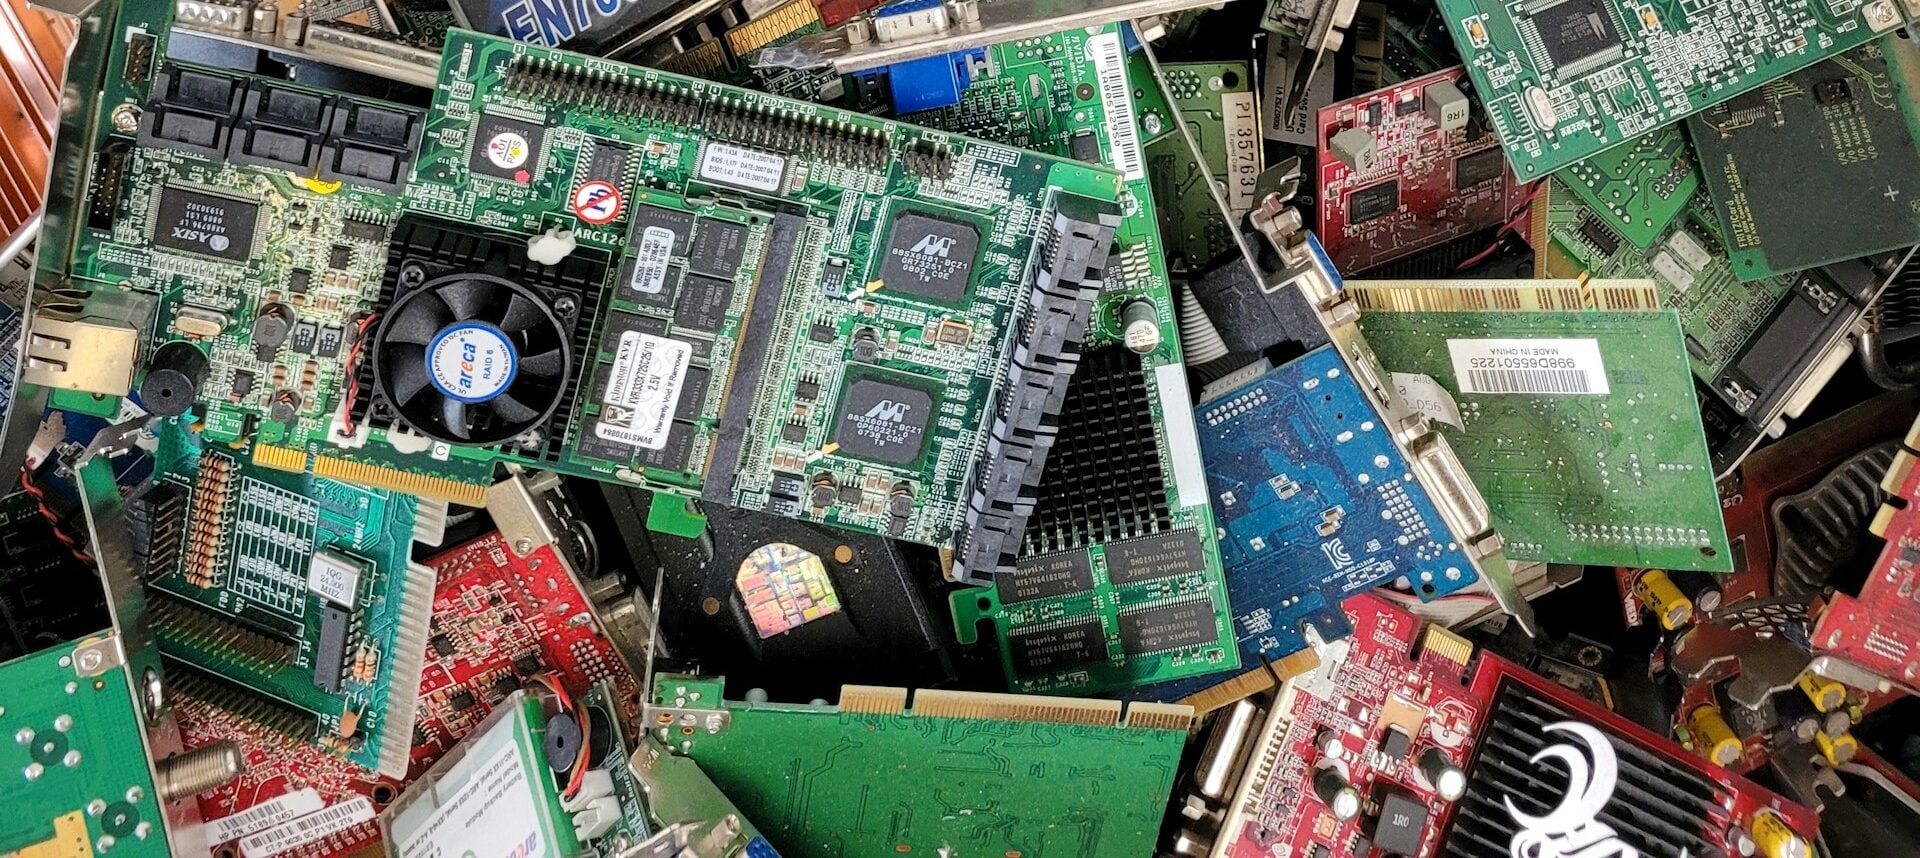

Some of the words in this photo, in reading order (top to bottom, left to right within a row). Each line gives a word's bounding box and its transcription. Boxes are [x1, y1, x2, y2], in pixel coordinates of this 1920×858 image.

[587, 61, 625, 75] FAULT
[763, 97, 815, 115] HDD-LED
[1446, 108, 1466, 122] 1R6
[1297, 113, 1306, 134] Card
[1849, 118, 1861, 145] Address
[1859, 117, 1871, 143] Address
[924, 131, 946, 143] LCD
[1830, 123, 1842, 149] Address
[1839, 120, 1852, 147] Address
[1237, 128, 1255, 198] 357631
[587, 189, 609, 214] Pb
[1726, 200, 1747, 248] FRITZ!Card
[171, 227, 211, 243] ASIX
[653, 265, 663, 280] ASSY
[659, 246, 667, 257] USA
[902, 264, 926, 275] 0802
[434, 338, 449, 371] APPROVED
[619, 338, 632, 361] KVR
[1489, 347, 1515, 356] CHINA
[1516, 348, 1530, 356] IN
[1533, 347, 1560, 356] MADE
[459, 342, 477, 389] areca
[482, 357, 493, 379] RAID
[494, 372, 507, 387] MADE
[647, 373, 661, 392] 2.5V
[654, 403, 670, 435] Warranty
[663, 388, 674, 404] Void
[669, 348, 684, 382] Removed
[1051, 560, 1073, 570] KOREA
[1127, 566, 1150, 578] KOREA
[1156, 560, 1189, 571] hynix
[218, 590, 230, 608] FDD
[1025, 634, 1057, 647] hynix
[1063, 630, 1086, 642] KOREA
[320, 713, 331, 726] 40
[364, 710, 379, 729] C10
[486, 778, 501, 793] Name
[463, 808, 485, 829] Module
[1392, 813, 1410, 828] 1R0
